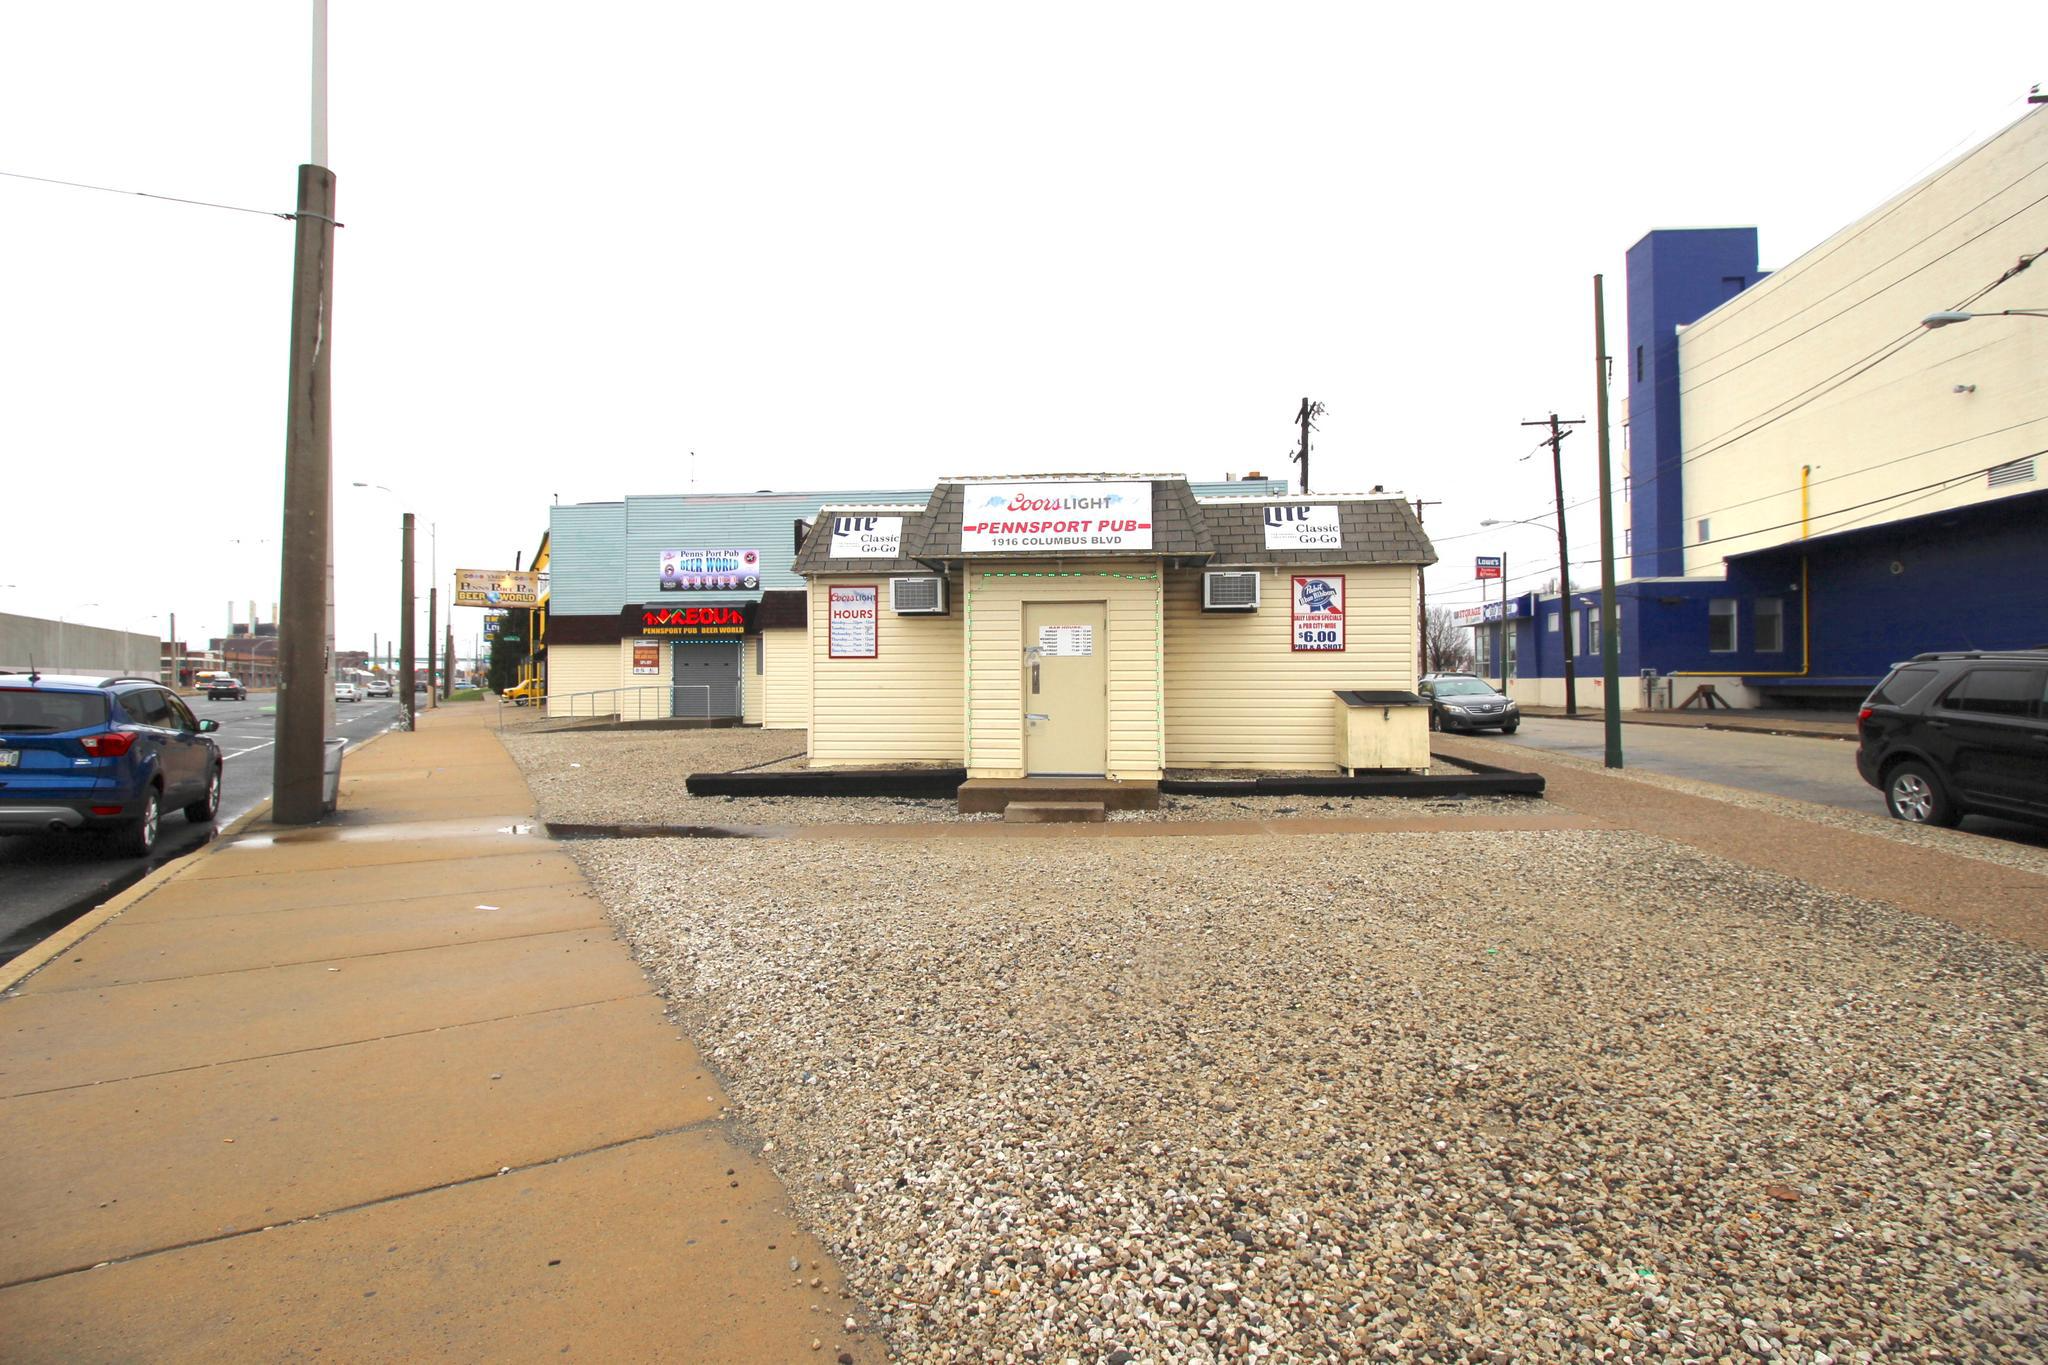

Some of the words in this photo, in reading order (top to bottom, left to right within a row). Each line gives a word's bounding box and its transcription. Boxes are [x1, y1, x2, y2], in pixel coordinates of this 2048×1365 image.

[1007, 493, 1063, 511] Coors
[1064, 497, 1111, 510] LIGHT
[977, 520, 1092, 534] PENNSPORT
[1098, 519, 1137, 532] PUB
[1296, 524, 1338, 533] Classic
[861, 534, 899, 543] Classic
[992, 538, 1018, 547] 1916
[1022, 536, 1087, 546] COLUMBUS
[1091, 536, 1122, 545] BLVD
[1299, 534, 1337, 544] Go-Go
[861, 544, 896, 553] Go-Go
[680, 550, 703, 558] Penns
[680, 558, 703, 573] BEER
[706, 558, 739, 573] WORLD
[459, 592, 486, 600] BEER
[499, 593, 535, 602] WORLD
[831, 592, 854, 602] Coors
[833, 609, 873, 619] HOURS
[1298, 630, 1336, 643] $6.00
